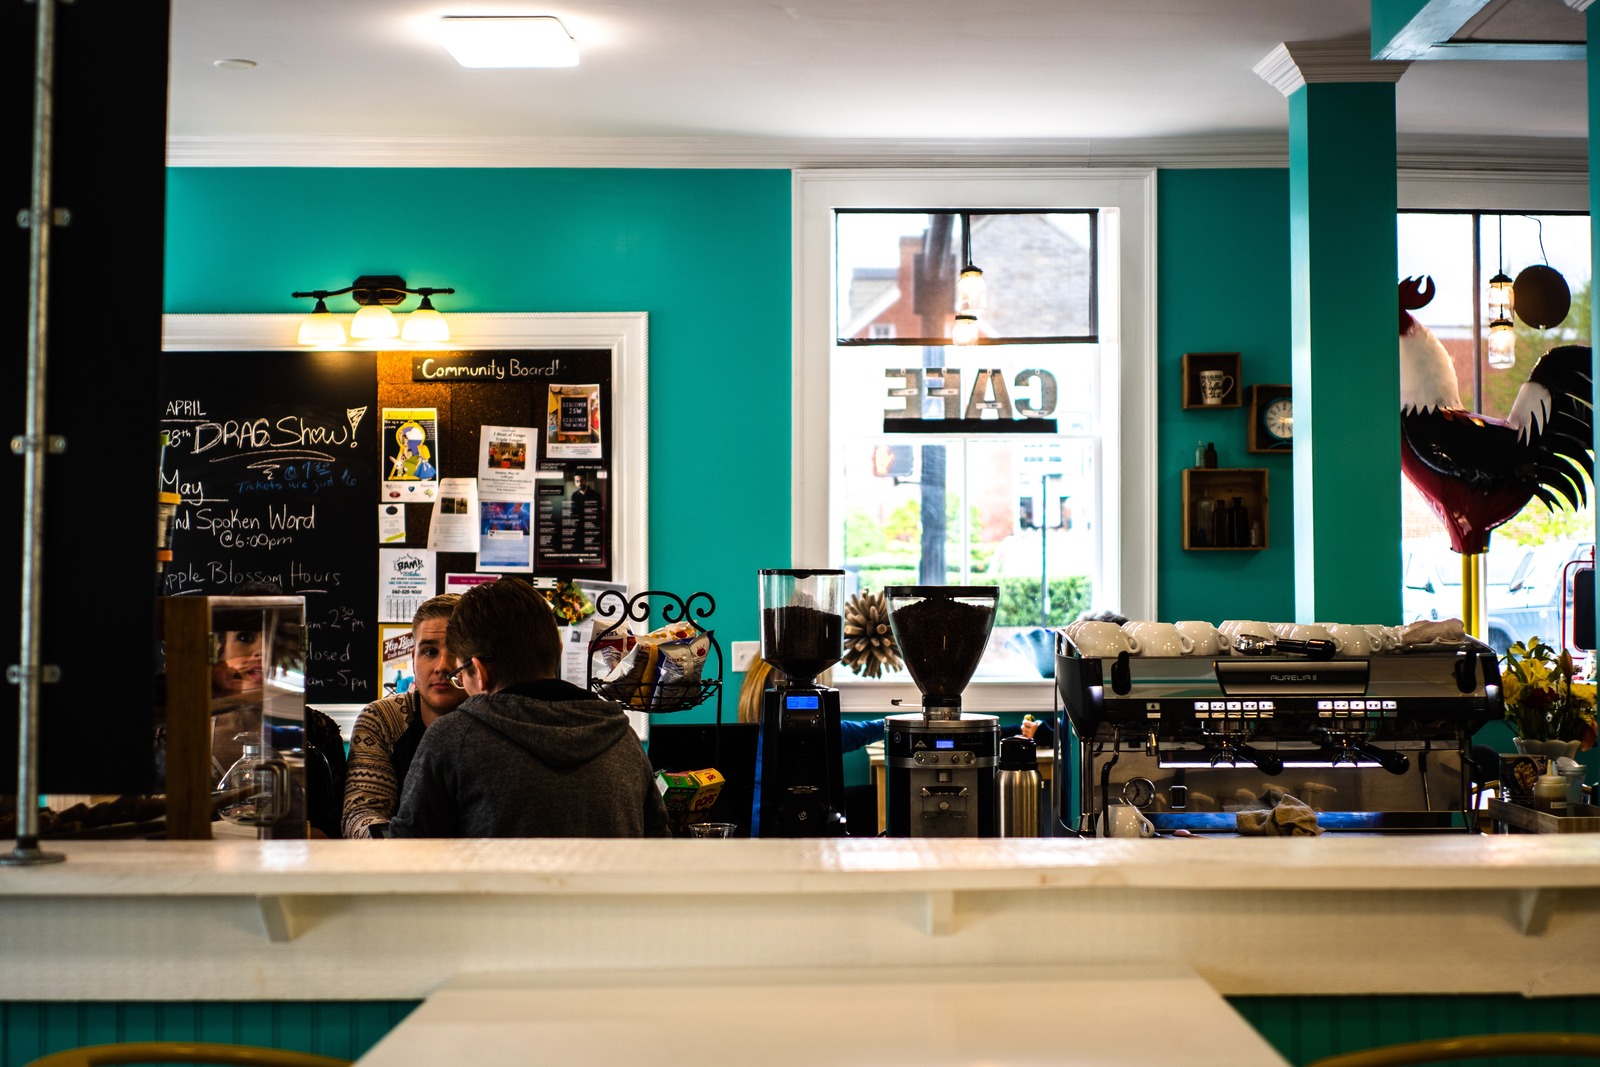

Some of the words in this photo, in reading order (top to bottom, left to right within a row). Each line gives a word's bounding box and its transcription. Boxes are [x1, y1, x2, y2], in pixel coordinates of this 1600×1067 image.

[421, 358, 505, 379] Community
[509, 358, 559, 377] Board!
[165, 400, 207, 416] APRIL
[190, 418, 271, 454] DRAG
[269, 405, 368, 449] Show!
[160, 468, 205, 506] May
[196, 508, 260, 535] Spoken
[268, 504, 316, 530] Word
[166, 562, 206, 589] pple
[207, 560, 283, 584] Blossom
[290, 560, 341, 588] Hours
[305, 641, 351, 661] losed
[1270, 674, 1312, 682] AURELIA
